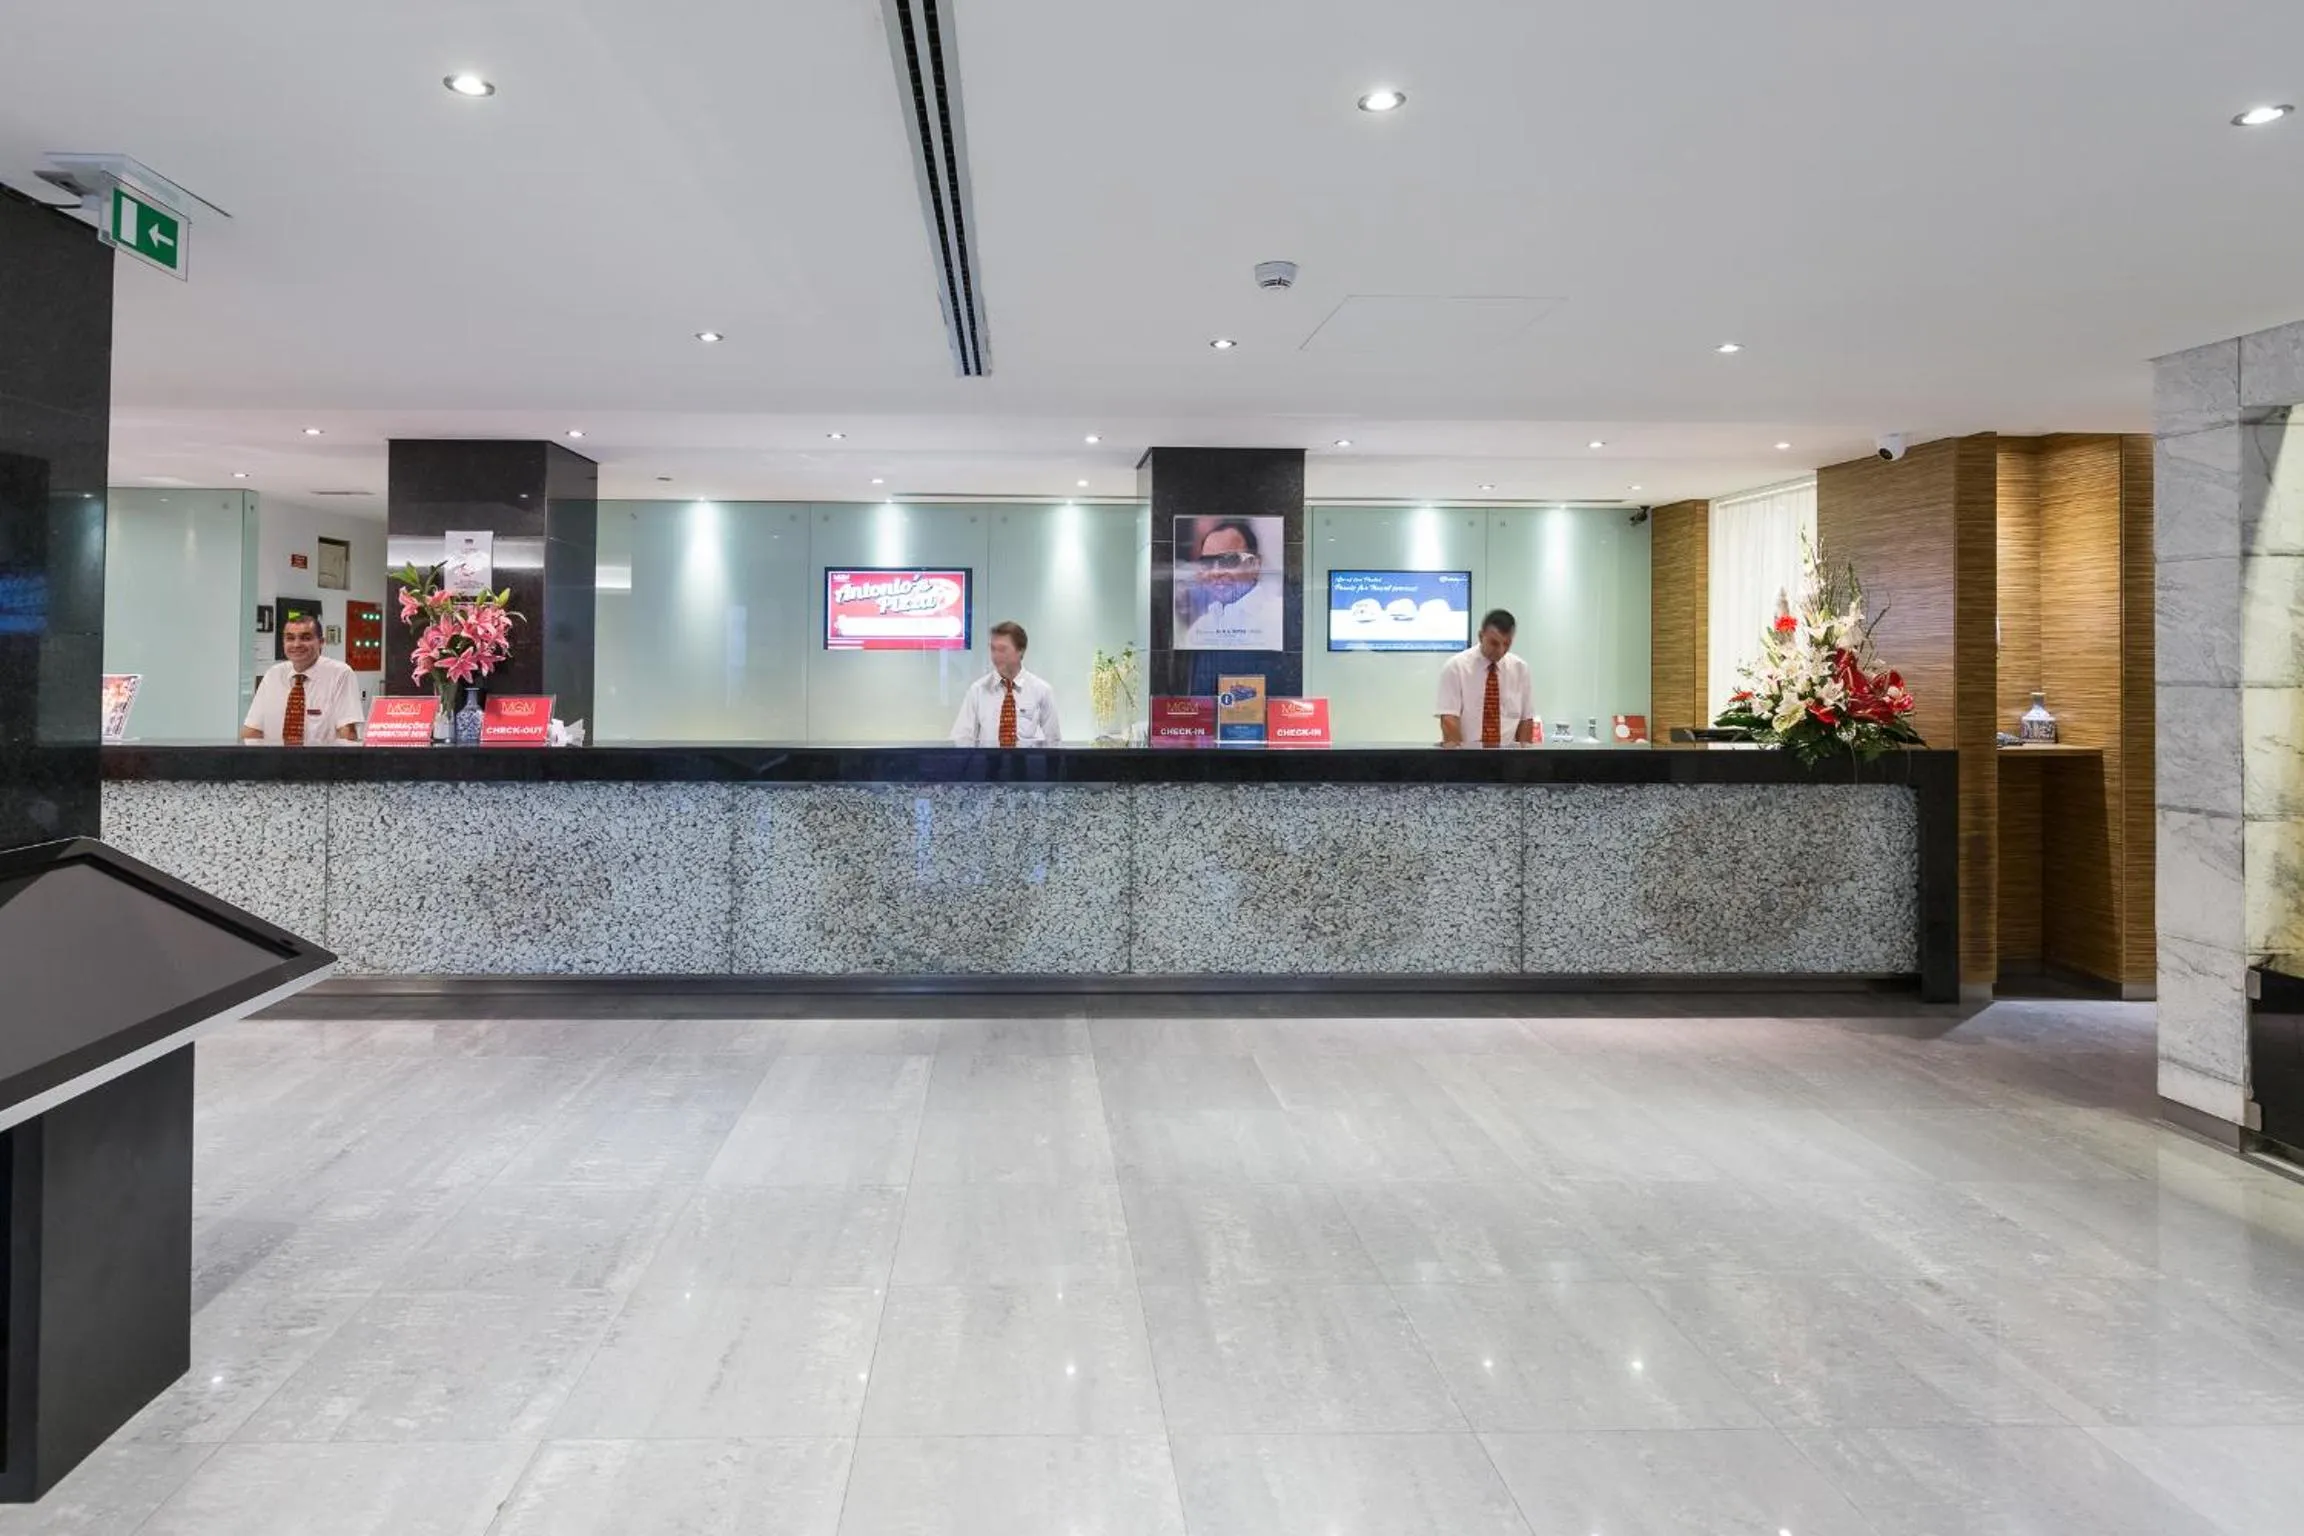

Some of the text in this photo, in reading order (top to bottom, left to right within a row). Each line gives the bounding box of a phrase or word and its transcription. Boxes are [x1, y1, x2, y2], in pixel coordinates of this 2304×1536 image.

[501, 701, 536, 713] MGM
[1167, 701, 1199, 712] MGM
[486, 725, 543, 736] CHECK-OUT
[1160, 727, 1205, 736] CHECK-IN
[1277, 728, 1322, 737] CHECK-IN
